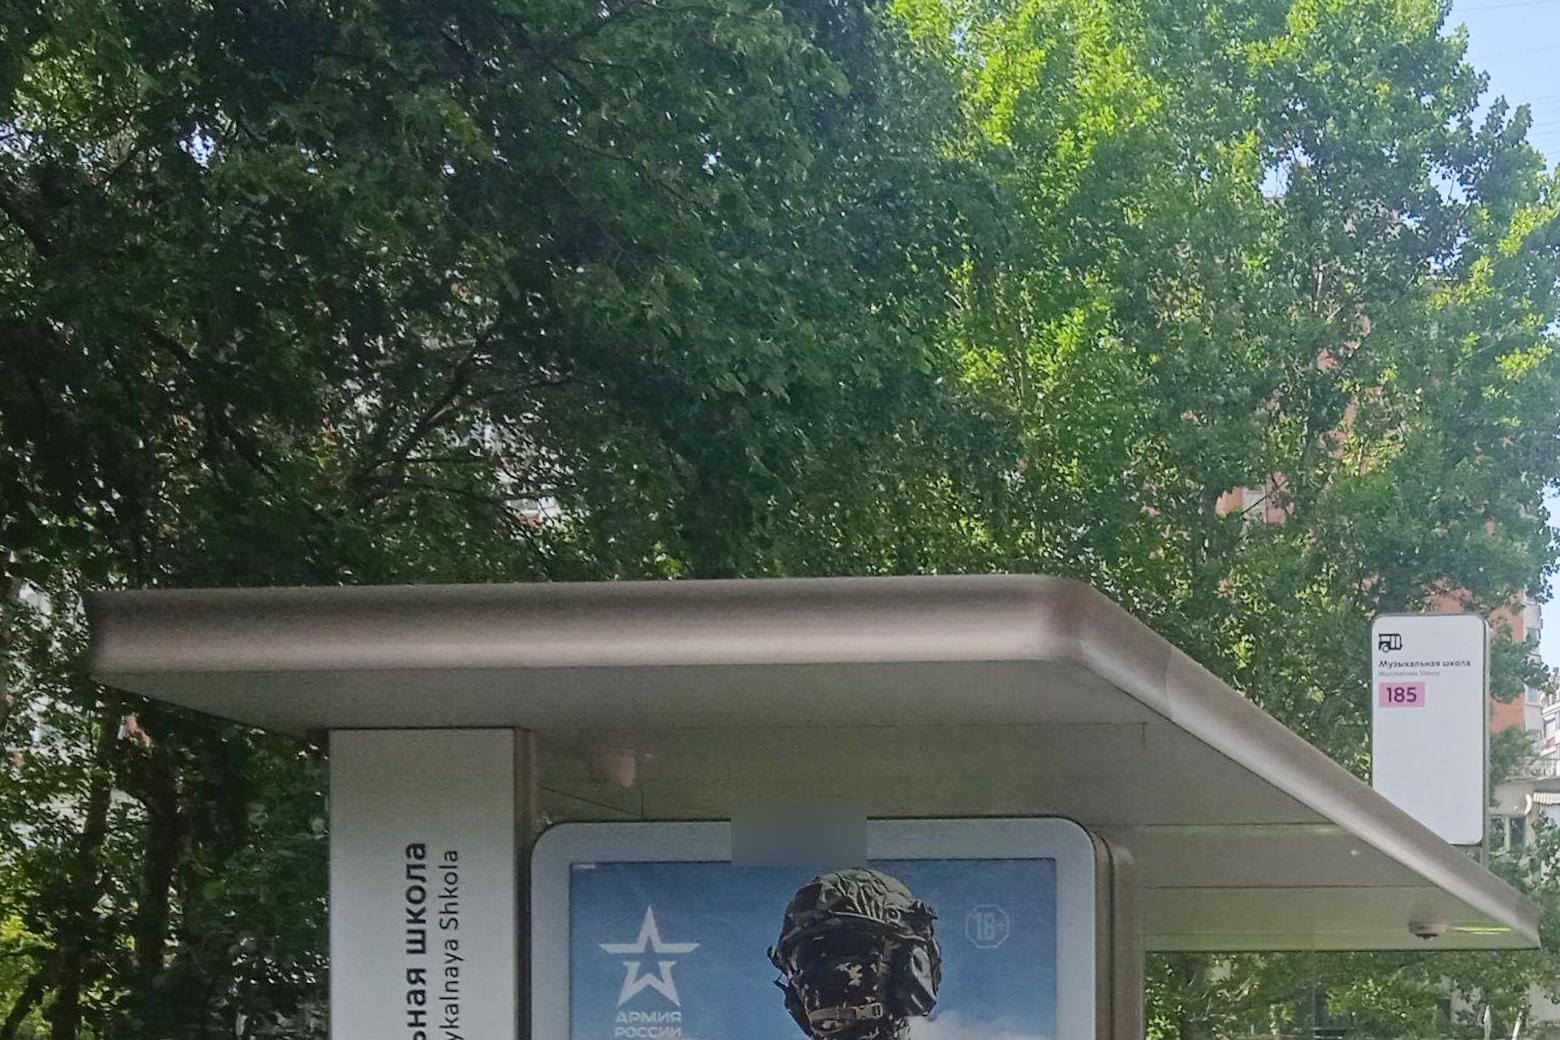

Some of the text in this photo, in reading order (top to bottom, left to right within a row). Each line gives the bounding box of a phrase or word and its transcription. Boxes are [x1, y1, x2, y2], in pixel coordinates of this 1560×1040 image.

[1378, 660, 1440, 669] Музыкальная
[1386, 687, 1417, 703] 185
[438, 849, 459, 930] Shkola
[405, 842, 427, 954] школа
[615, 1011, 682, 1023] АРМИЯ
[613, 1026, 682, 1038] РОССИИ
